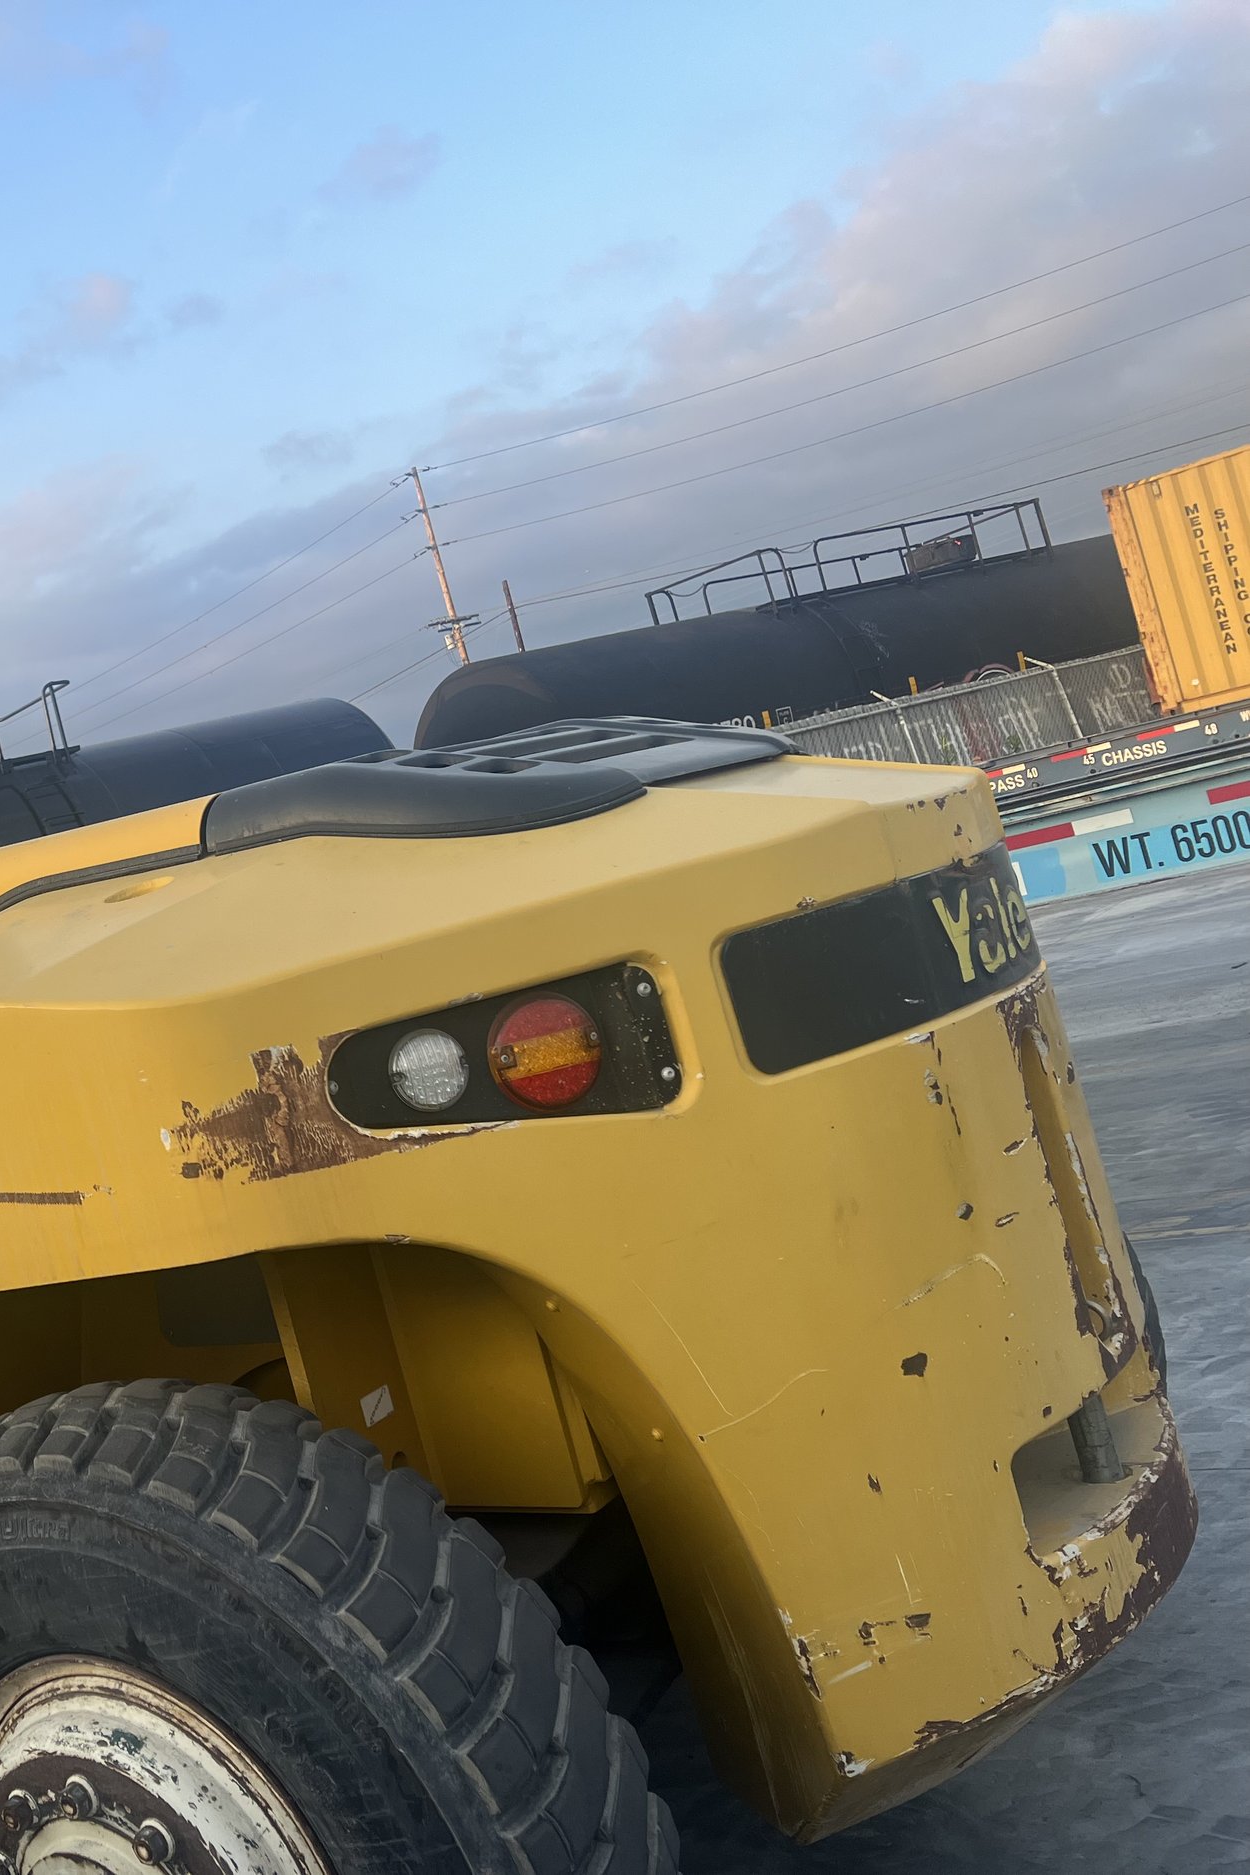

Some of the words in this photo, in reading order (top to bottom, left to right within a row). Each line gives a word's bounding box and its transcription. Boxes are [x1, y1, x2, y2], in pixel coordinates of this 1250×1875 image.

[1214, 507, 1249, 601] SHIPPING
[1184, 502, 1237, 655] MEDITERRANEAN
[1204, 723, 1218, 736] 48
[1083, 753, 1096, 766] 45
[1101, 740, 1168, 767] CHASSIS
[1026, 767, 1039, 779] 40
[1092, 831, 1165, 878] WT.
[932, 877, 1031, 983] Yale
